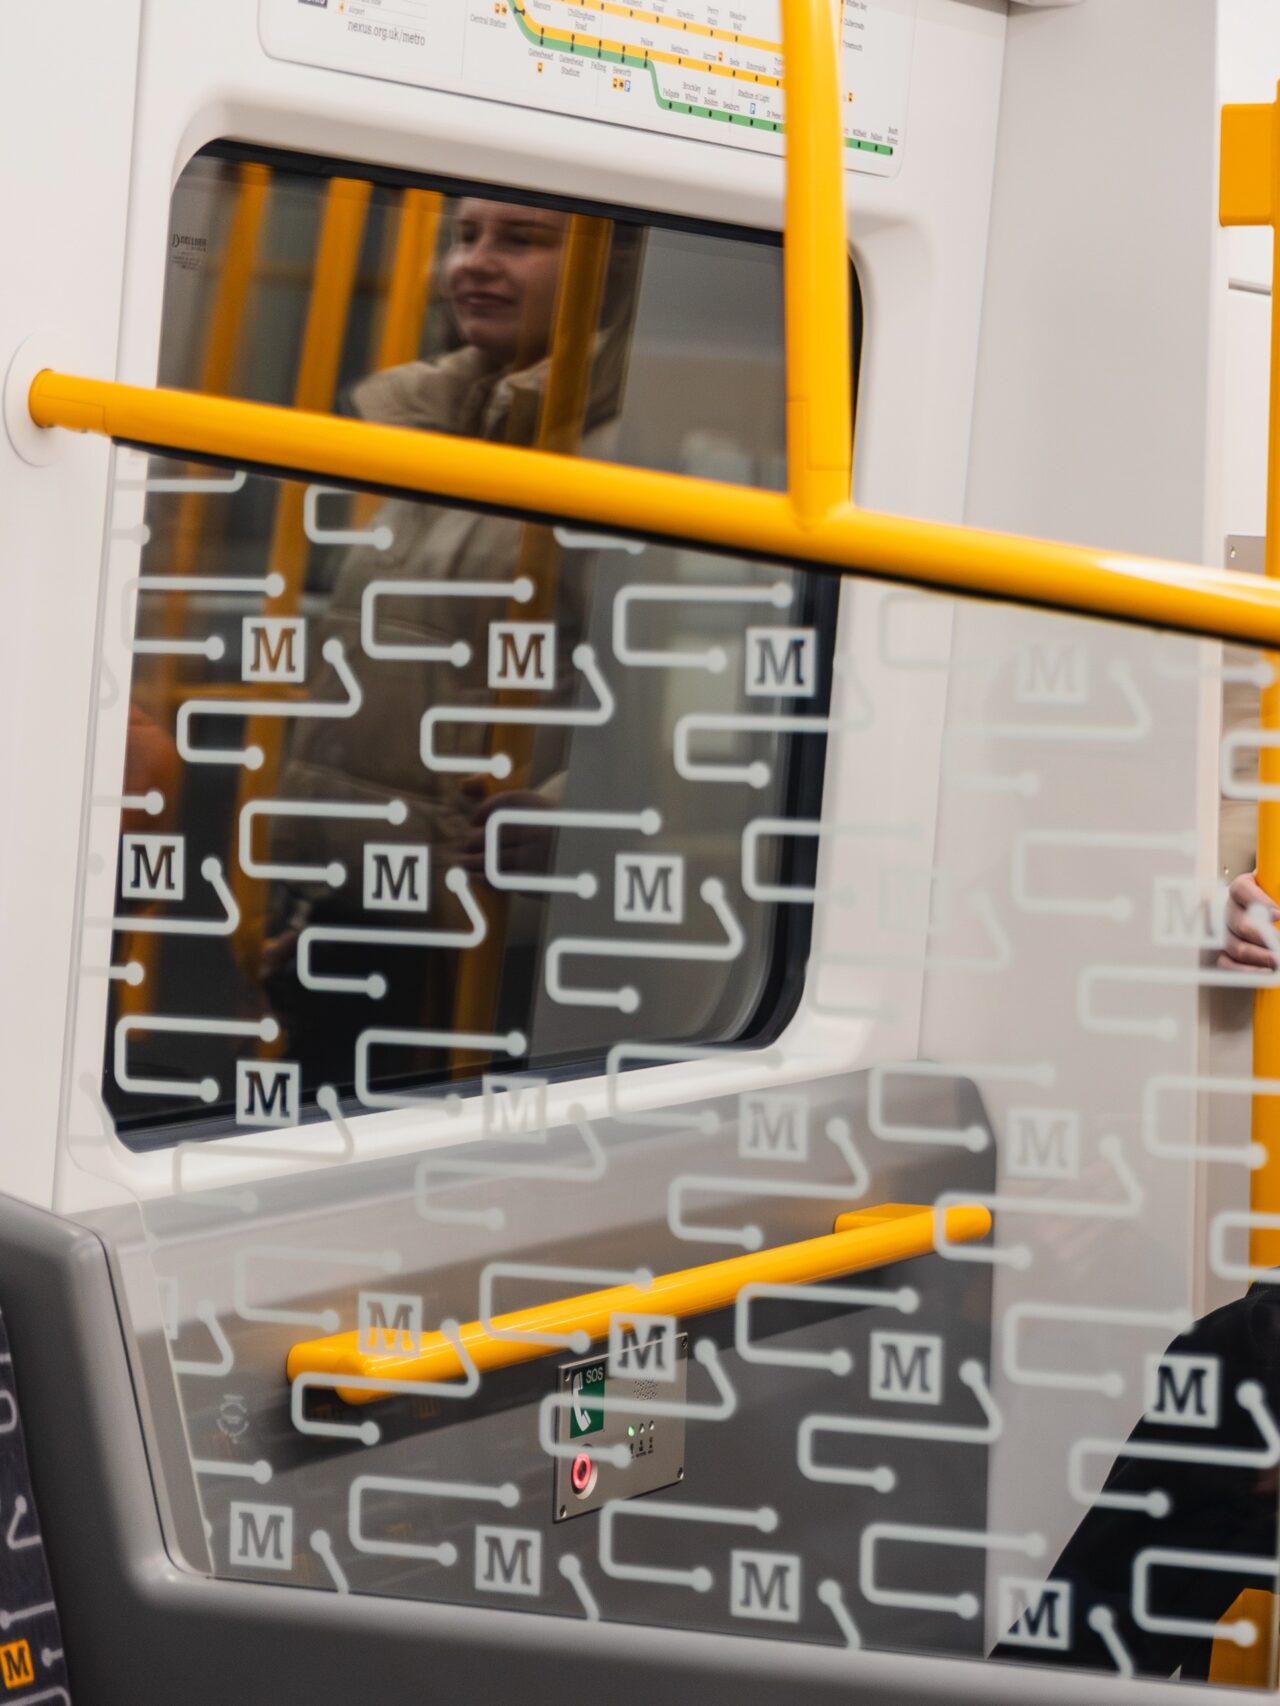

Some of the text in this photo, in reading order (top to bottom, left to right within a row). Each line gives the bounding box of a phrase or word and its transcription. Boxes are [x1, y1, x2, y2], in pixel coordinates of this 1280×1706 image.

[347, 20, 425, 46] nexus.org.uk/metro
[250, 627, 296, 672] M
[498, 633, 545, 679] M
[756, 639, 805, 685] M
[131, 844, 175, 890] M
[372, 854, 419, 901] M
[624, 865, 672, 912] M
[245, 1071, 290, 1117] M
[749, 1102, 798, 1151] M
[367, 1301, 414, 1350] M
[617, 1321, 667, 1370] M
[586, 1367, 604, 1384] SOS
[880, 1342, 931, 1393] M
[1153, 1365, 1207, 1415] M
[238, 1511, 284, 1560] M
[484, 1535, 532, 1586] M
[741, 1561, 790, 1611] M
[1007, 1588, 1060, 1638] M
[3, 1645, 29, 1683] M
